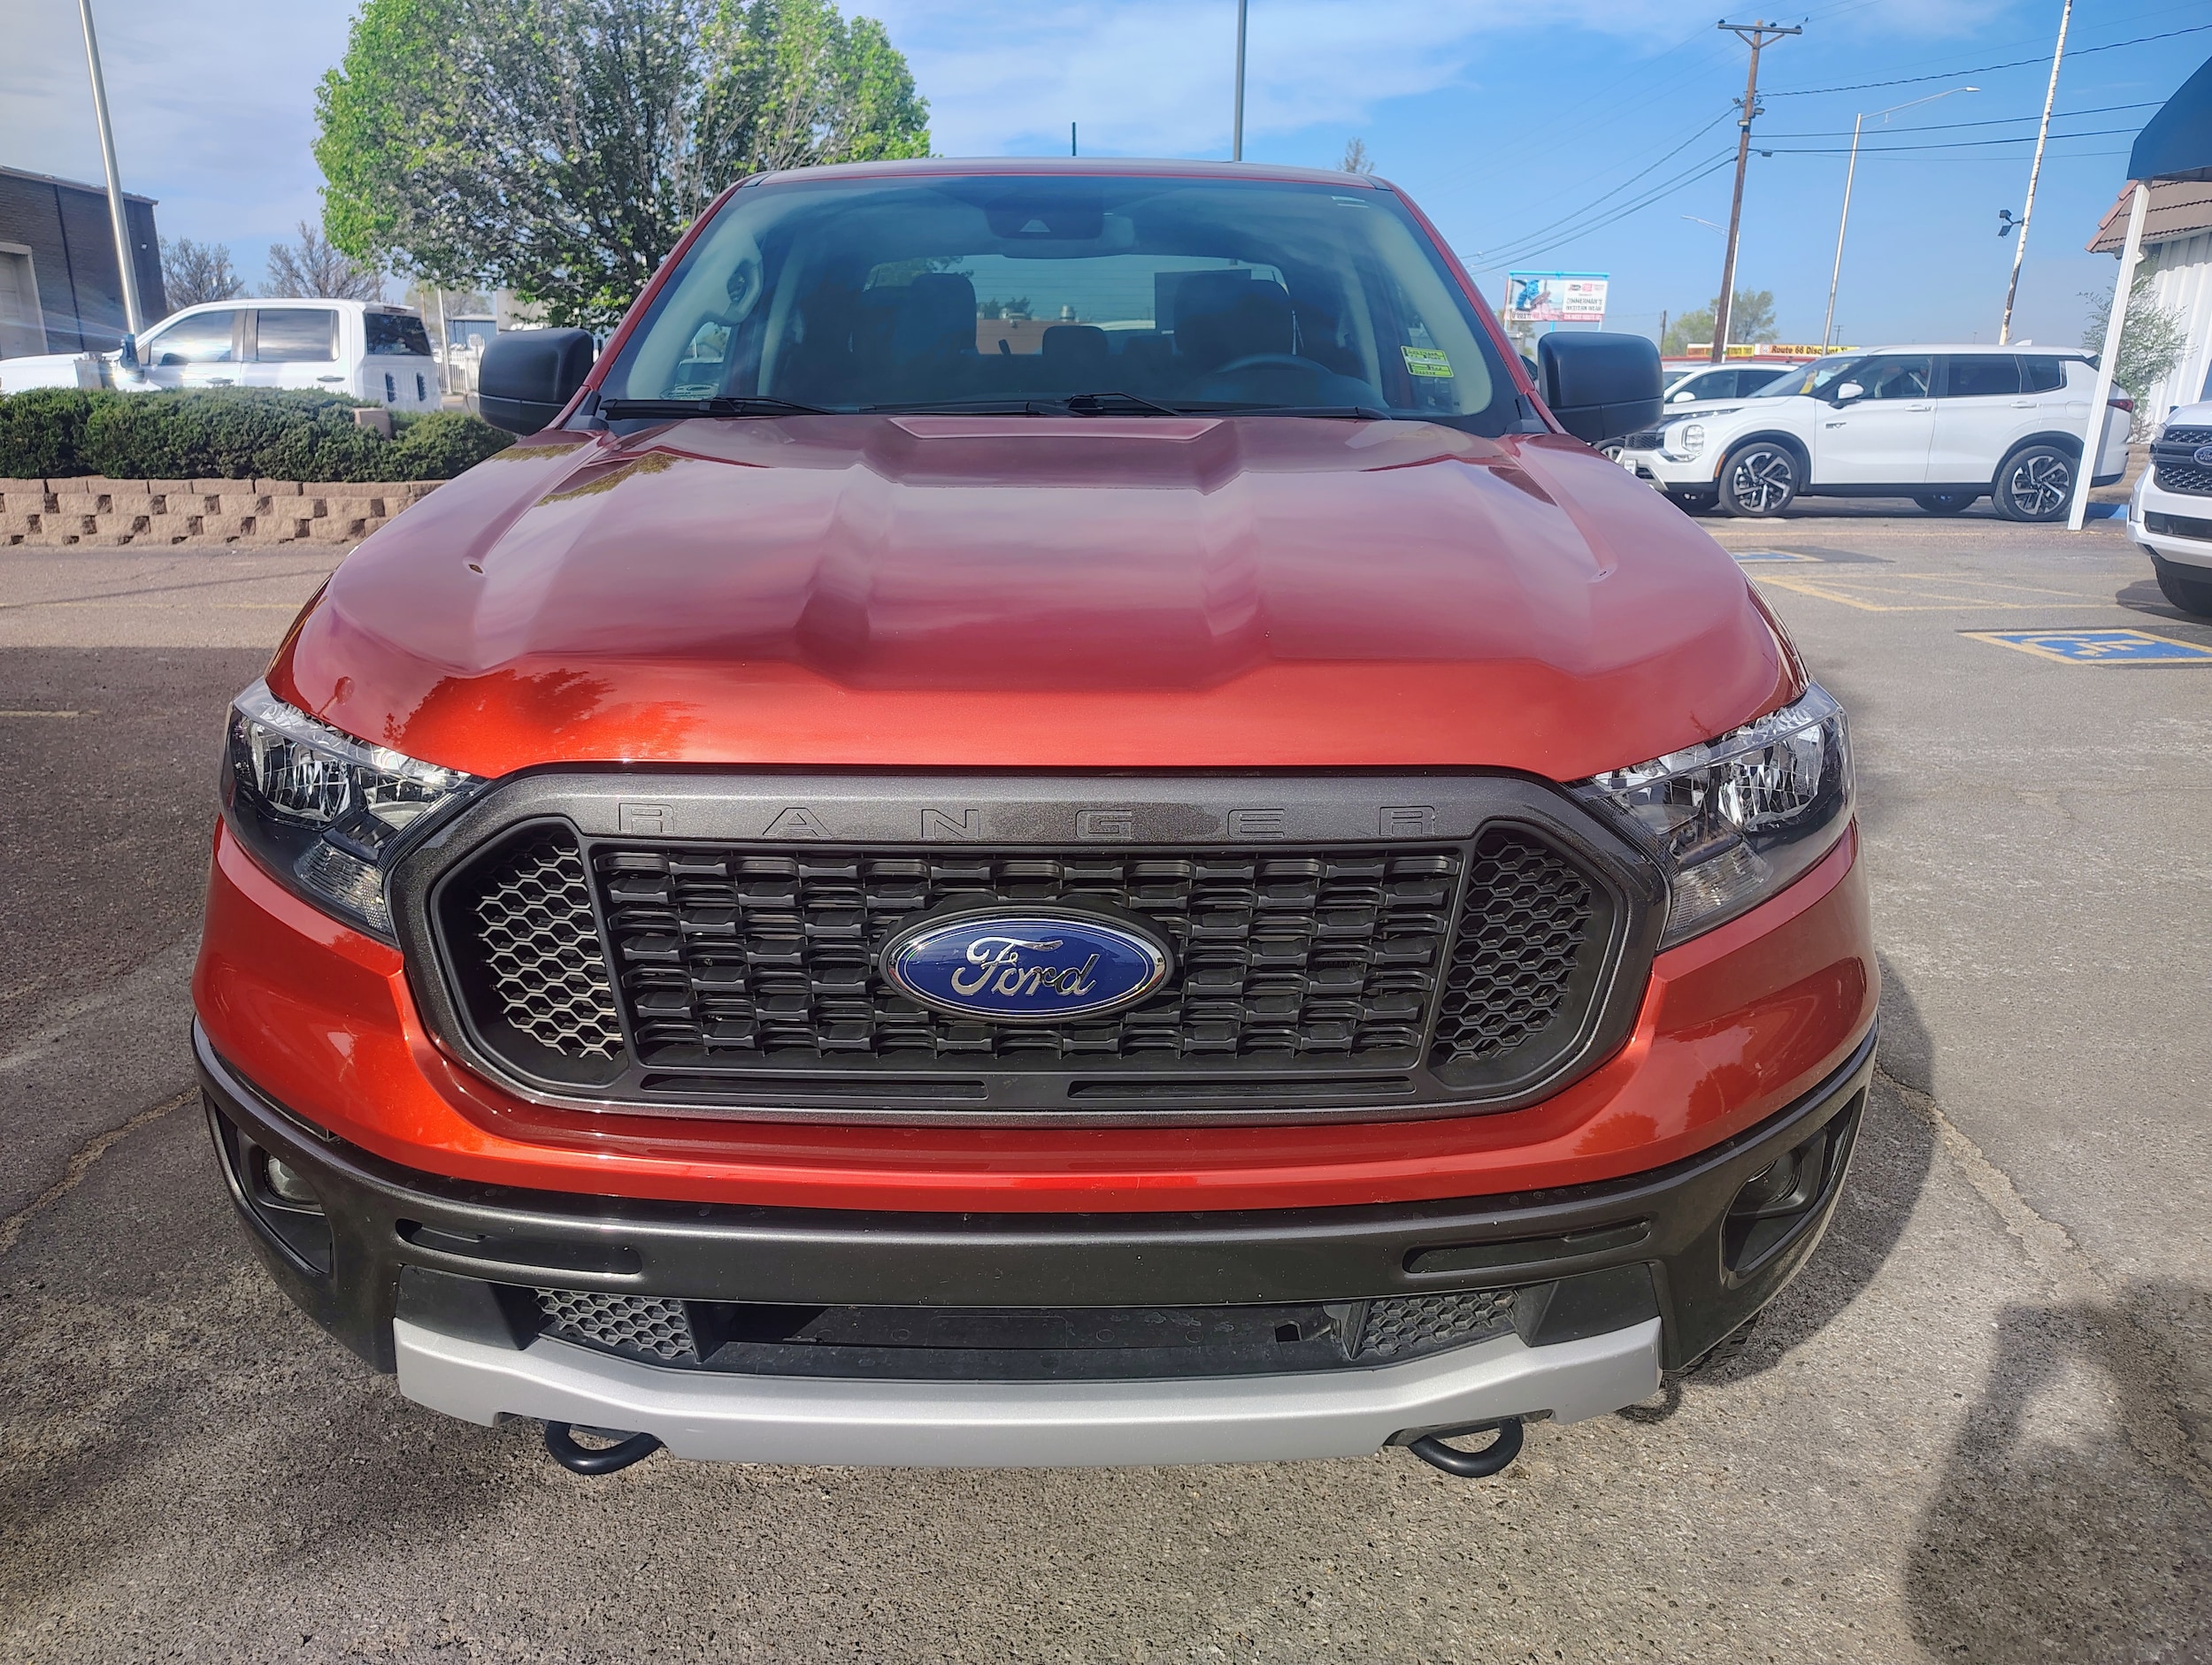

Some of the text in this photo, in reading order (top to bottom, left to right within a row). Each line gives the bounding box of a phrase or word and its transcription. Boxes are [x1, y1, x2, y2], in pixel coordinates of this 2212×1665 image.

[1770, 345, 1793, 354] Route
[1806, 346, 1839, 355] Discunt
[618, 802, 1436, 840] RANGER
[950, 936, 1102, 996] Ford
